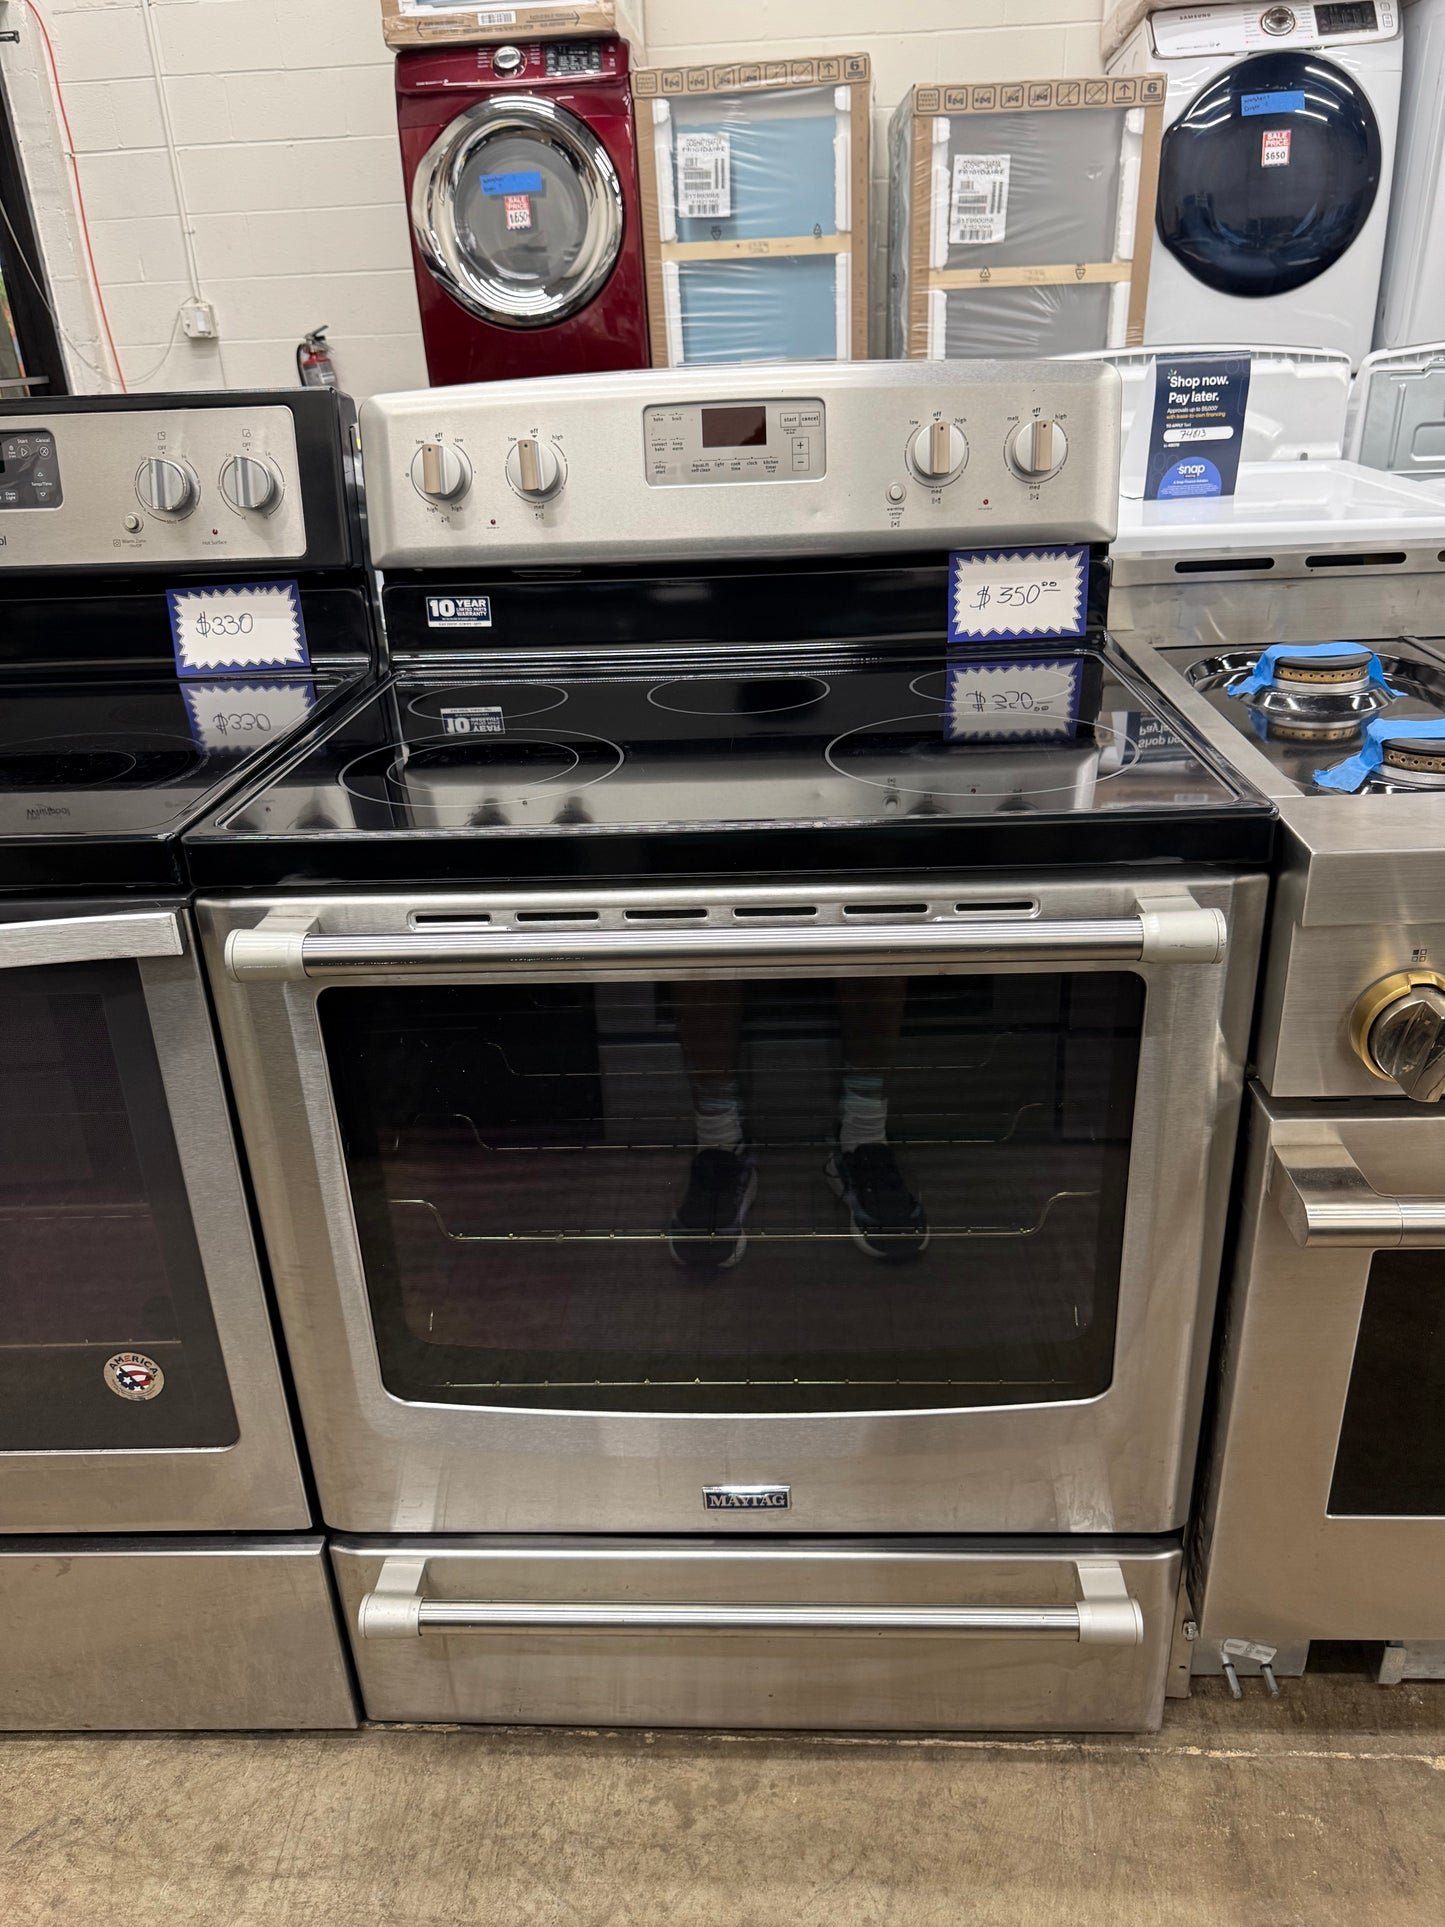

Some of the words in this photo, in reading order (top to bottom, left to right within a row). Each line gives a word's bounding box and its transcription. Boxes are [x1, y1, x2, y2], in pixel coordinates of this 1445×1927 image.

[1149, 82, 1158, 93] 6
[1265, 139, 1289, 147] PRICE
[1266, 132, 1288, 140] SALE
[1265, 151, 1286, 160] $650
[1169, 375, 1200, 389] Shop
[1202, 375, 1229, 386] now.
[1168, 392, 1190, 405] Pay
[1191, 391, 1219, 402] later.
[1178, 464, 1206, 476] snap
[430, 599, 455, 617] 10
[455, 599, 487, 608] YEAR
[195, 611, 253, 638] $330
[108, 1354, 159, 1375] AMERICA
[708, 1493, 786, 1507] MAYTAG
